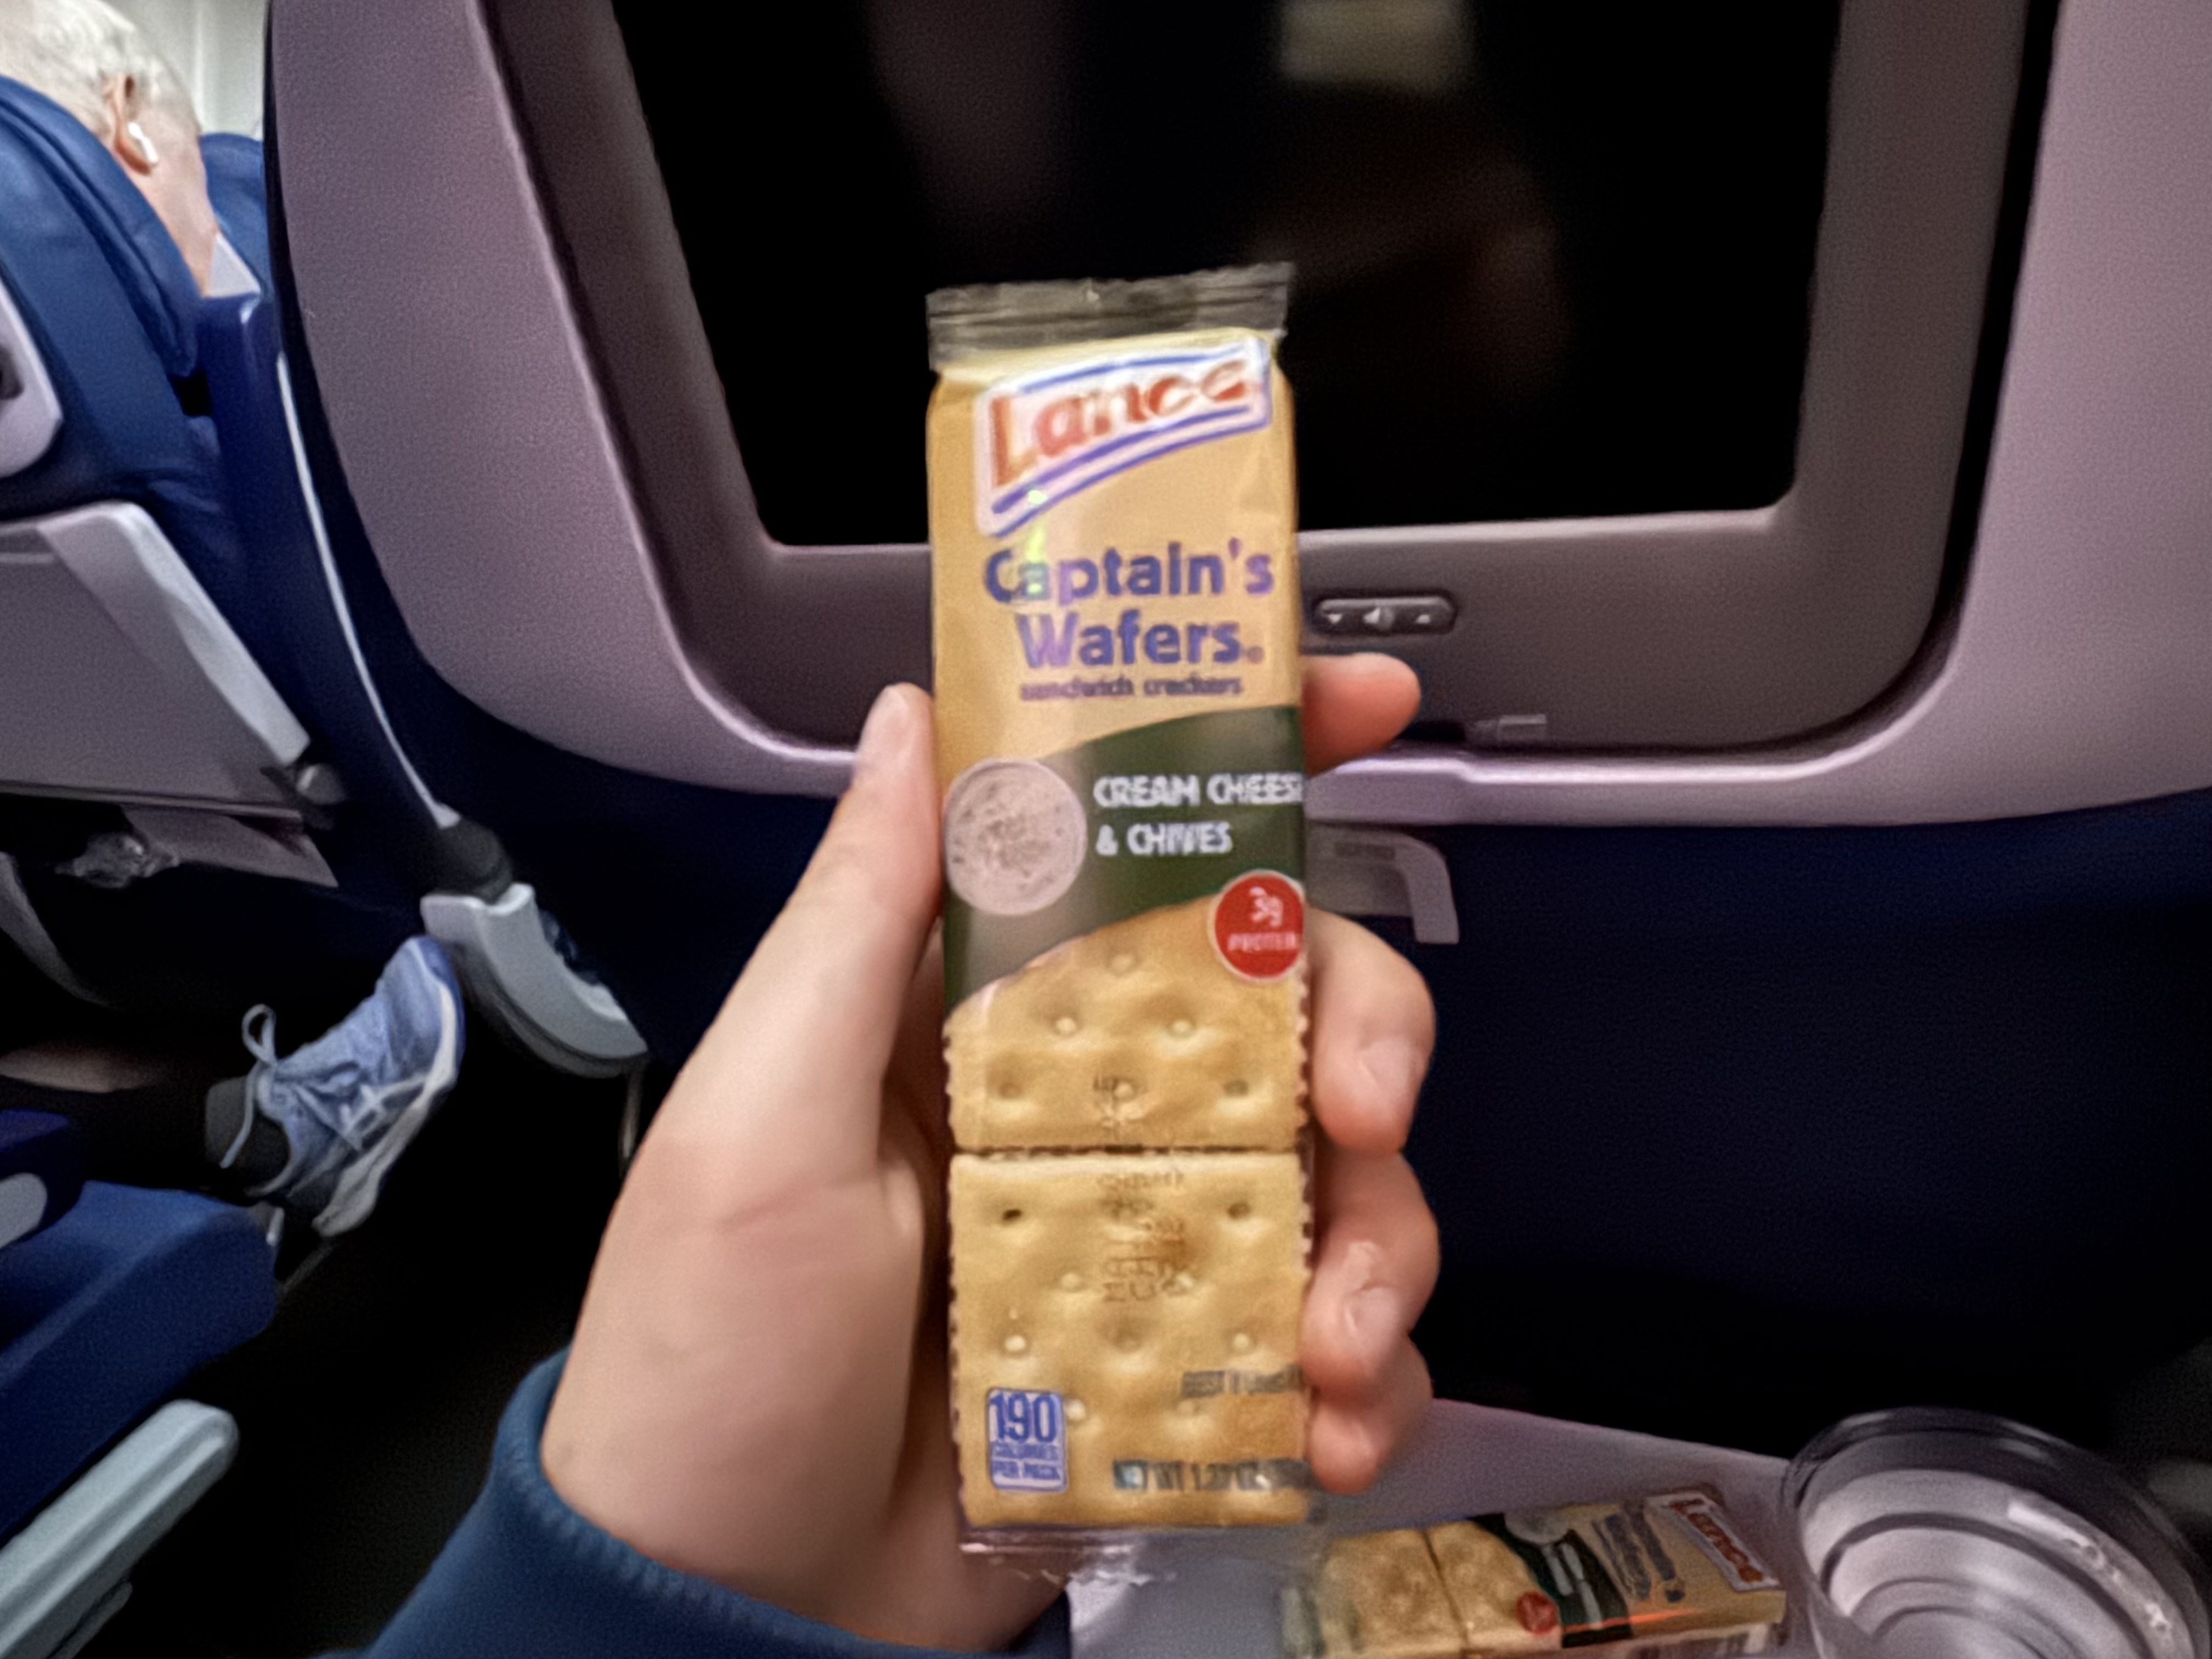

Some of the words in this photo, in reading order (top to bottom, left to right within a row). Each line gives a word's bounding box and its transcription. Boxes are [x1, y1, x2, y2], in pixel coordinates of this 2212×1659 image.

[989, 359, 1248, 487] Lance
[984, 537, 1274, 605] Captain's
[1015, 608, 1241, 669] Wafers
[1020, 675, 1135, 701] sandwich
[1143, 672, 1243, 697] crackers
[1093, 774, 1200, 807] CREAM
[1096, 824, 1118, 856] &
[1127, 821, 1233, 854] CHIVES
[1249, 886, 1284, 929] 3g
[988, 1392, 1057, 1443] 190
